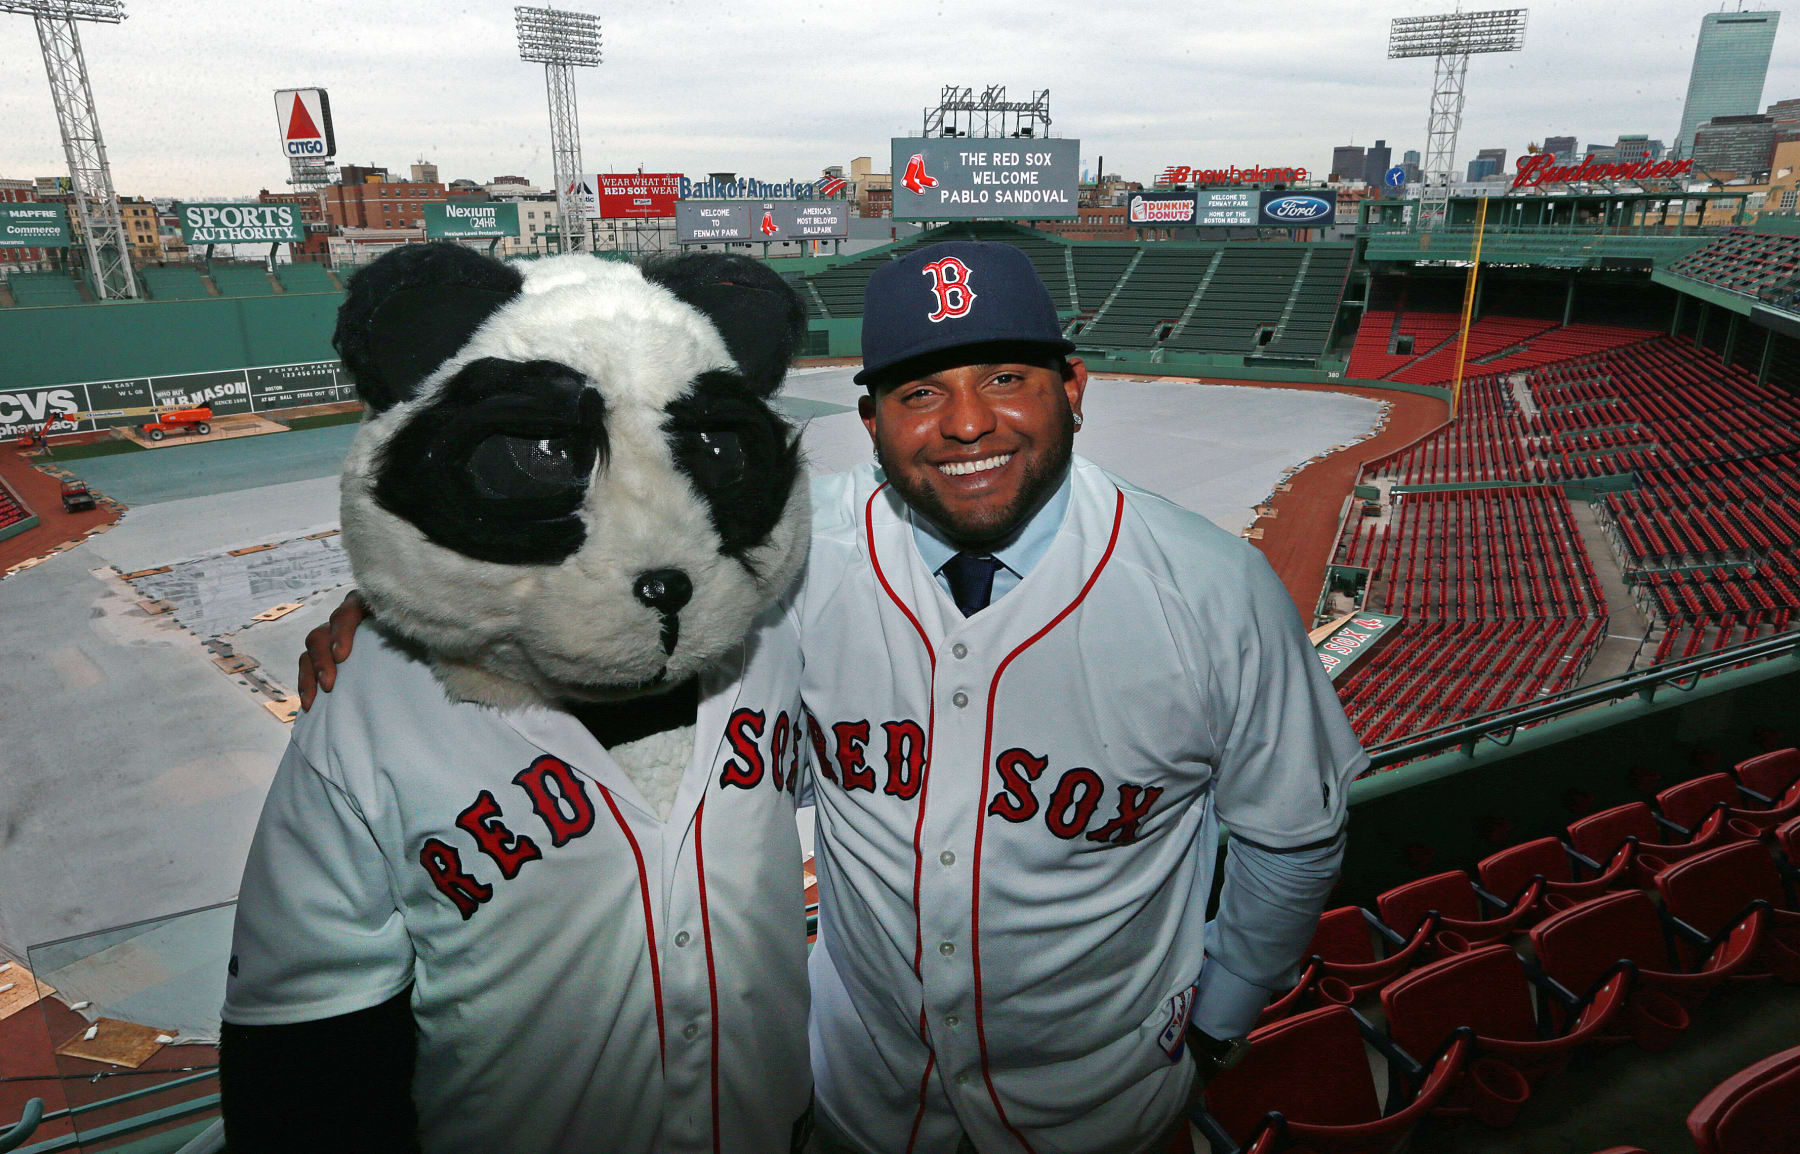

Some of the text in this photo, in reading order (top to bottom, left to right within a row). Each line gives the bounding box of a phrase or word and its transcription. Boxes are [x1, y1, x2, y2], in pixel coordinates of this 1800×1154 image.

[288, 140, 323, 154] CITGO
[960, 152, 1052, 166] THE RED SOX
[1512, 151, 1695, 188] Budweiser
[602, 177, 679, 186] WEAR WHAT THE
[972, 171, 1039, 185] WELCOME
[604, 186, 679, 195] RED SOX WEAR
[679, 176, 812, 199] Bank of America
[940, 190, 1068, 203] PABLO SANDOVAL
[445, 204, 496, 218] Nexium
[700, 208, 730, 217] WELCOME
[802, 207, 832, 215] AMERICA'S
[1148, 201, 1193, 210] DUNKIN'
[1276, 199, 1318, 217] Ford
[9, 210, 57, 218] MAPFRE
[186, 206, 293, 228] SPORTS
[797, 216, 838, 225] MOST BELOVED
[1147, 210, 1190, 220] DONUTS
[6, 225, 61, 234] Commerce
[711, 219, 720, 227] TO
[803, 226, 832, 234] BALLPARK
[191, 226, 295, 241] AUTHORITY
[693, 228, 739, 238] FENWAY PARK
[922, 256, 978, 323] B
[155, 389, 171, 398] WHO
[0, 389, 79, 424] CVS
[0, 420, 79, 439] pharmacy
[1324, 627, 1371, 656] SOX
[988, 747, 1164, 844] SOX
[419, 753, 596, 921] RED
